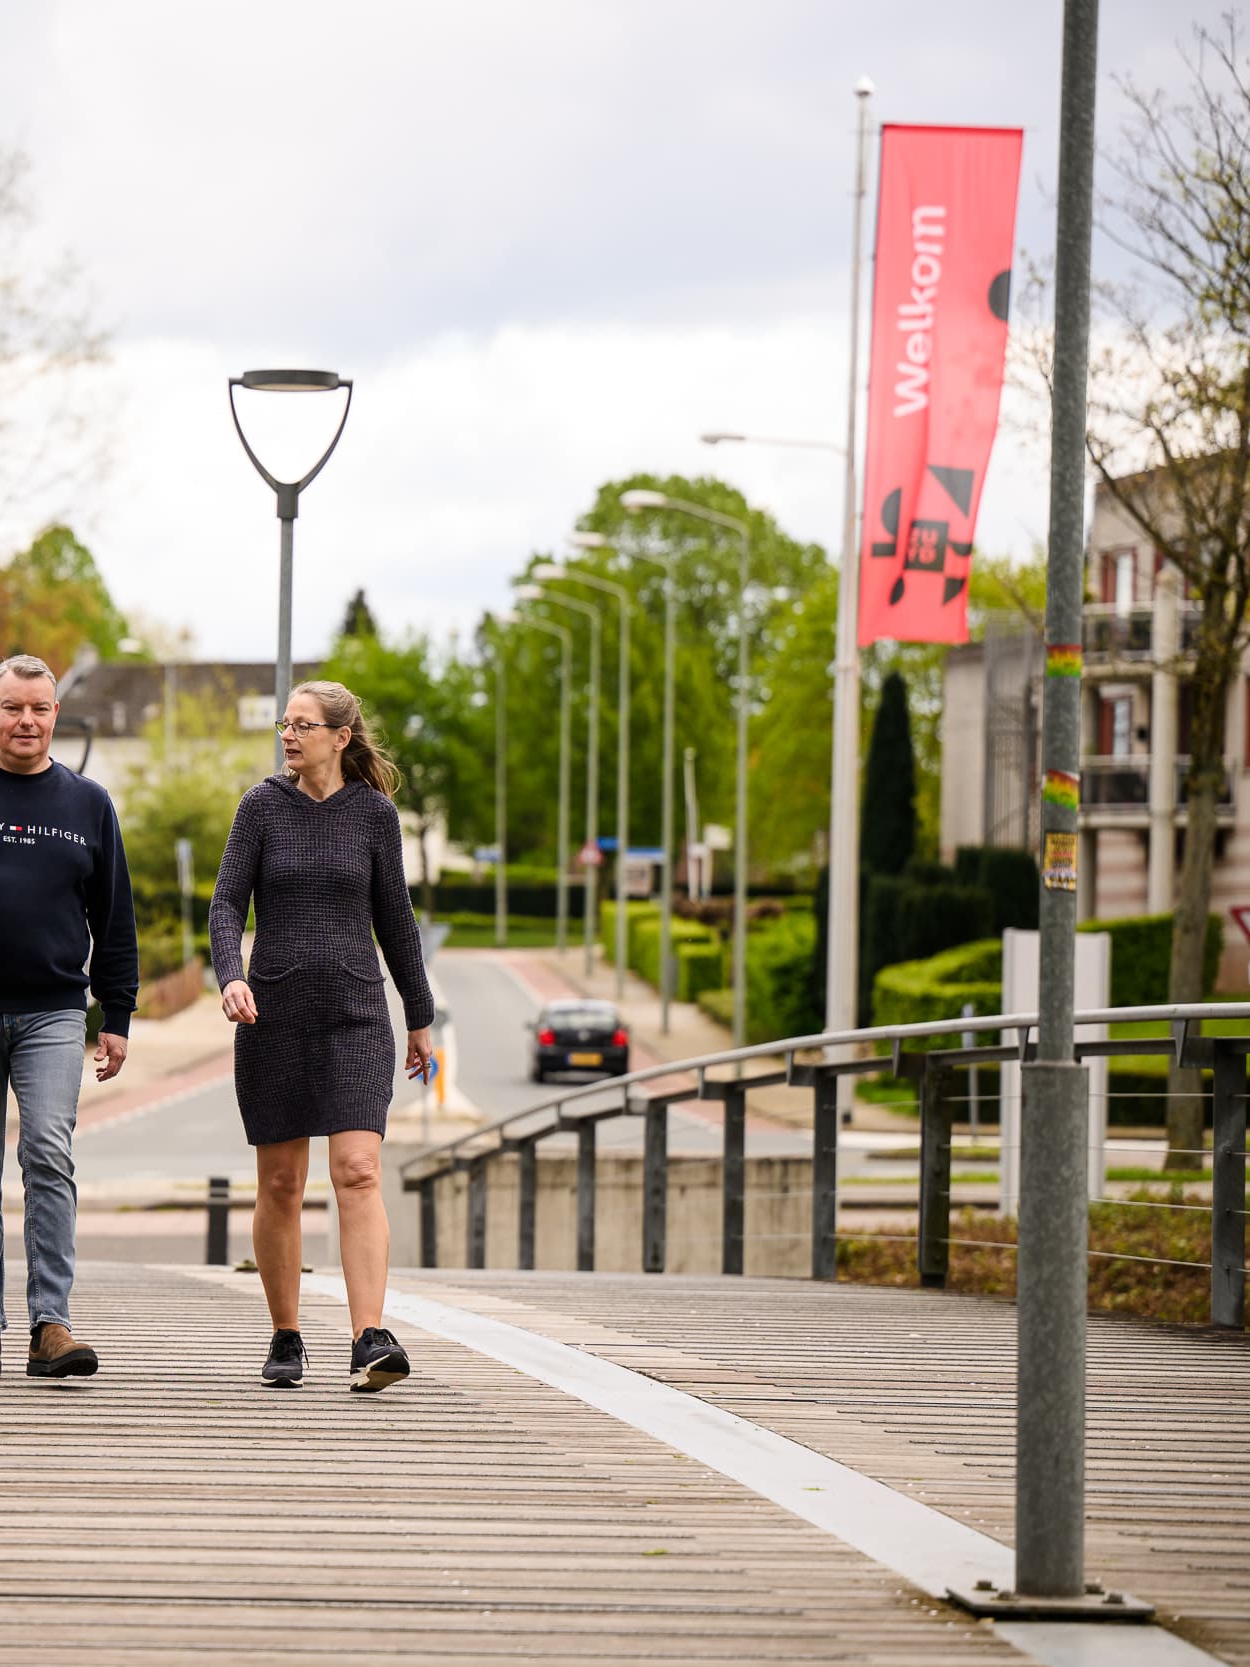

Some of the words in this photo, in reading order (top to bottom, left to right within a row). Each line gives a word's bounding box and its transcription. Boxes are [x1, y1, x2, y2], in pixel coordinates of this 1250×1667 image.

[893, 206, 947, 417] Welkom
[3, 835, 17, 844] EST.
[19, 837, 35, 845] 1985
[27, 825, 86, 846] HILFIGER
